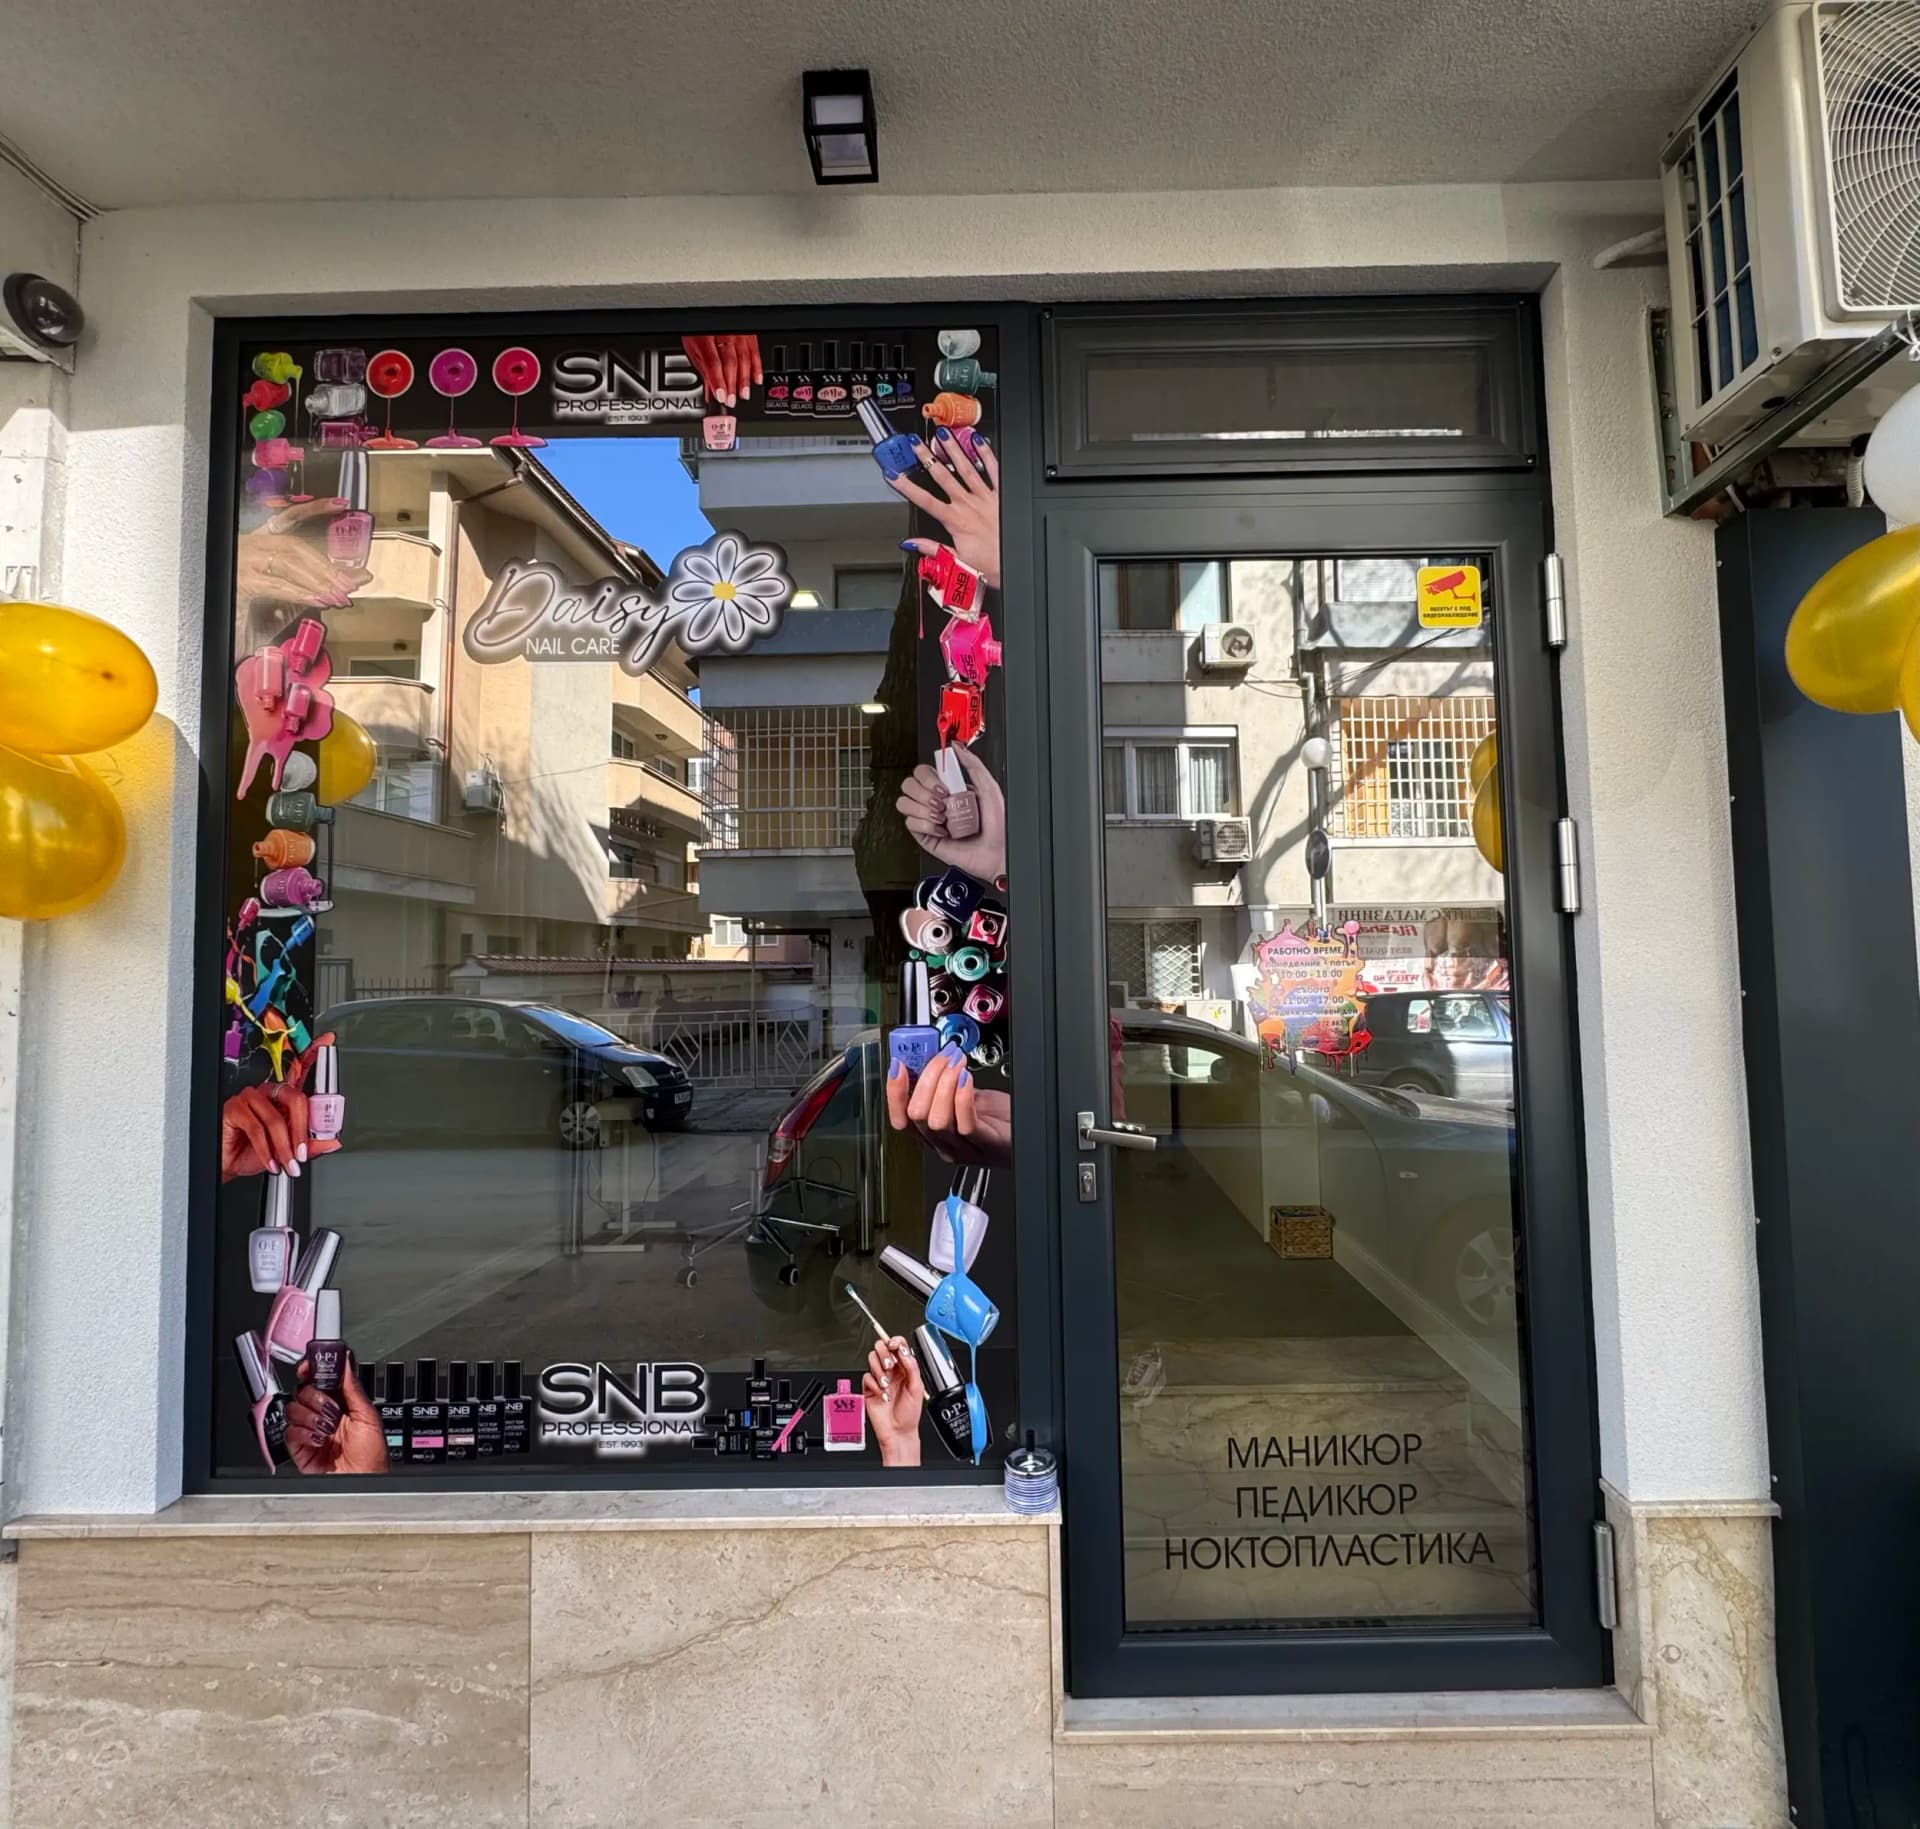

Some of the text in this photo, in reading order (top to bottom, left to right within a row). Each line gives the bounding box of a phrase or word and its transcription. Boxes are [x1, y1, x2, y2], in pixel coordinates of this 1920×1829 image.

[554, 350, 704, 395] SNB
[556, 397, 705, 413] PROFESSIONAL
[951, 571, 969, 604] SNB
[474, 566, 672, 664] Daisy
[526, 636, 621, 655] NAIL CARE
[1267, 945, 1343, 956] РАБОТНО ВРЕМЕ
[539, 1363, 706, 1416] SNB
[412, 1406, 440, 1416] SNB
[542, 1420, 705, 1436] PROFESSIONAL
[620, 1440, 645, 1449] 1993
[1227, 1433, 1423, 1469] МАНИКЮР
[1236, 1483, 1419, 1523] ПЕДИКЮР
[1164, 1532, 1495, 1571] НОКТОПЛАСТИКА
